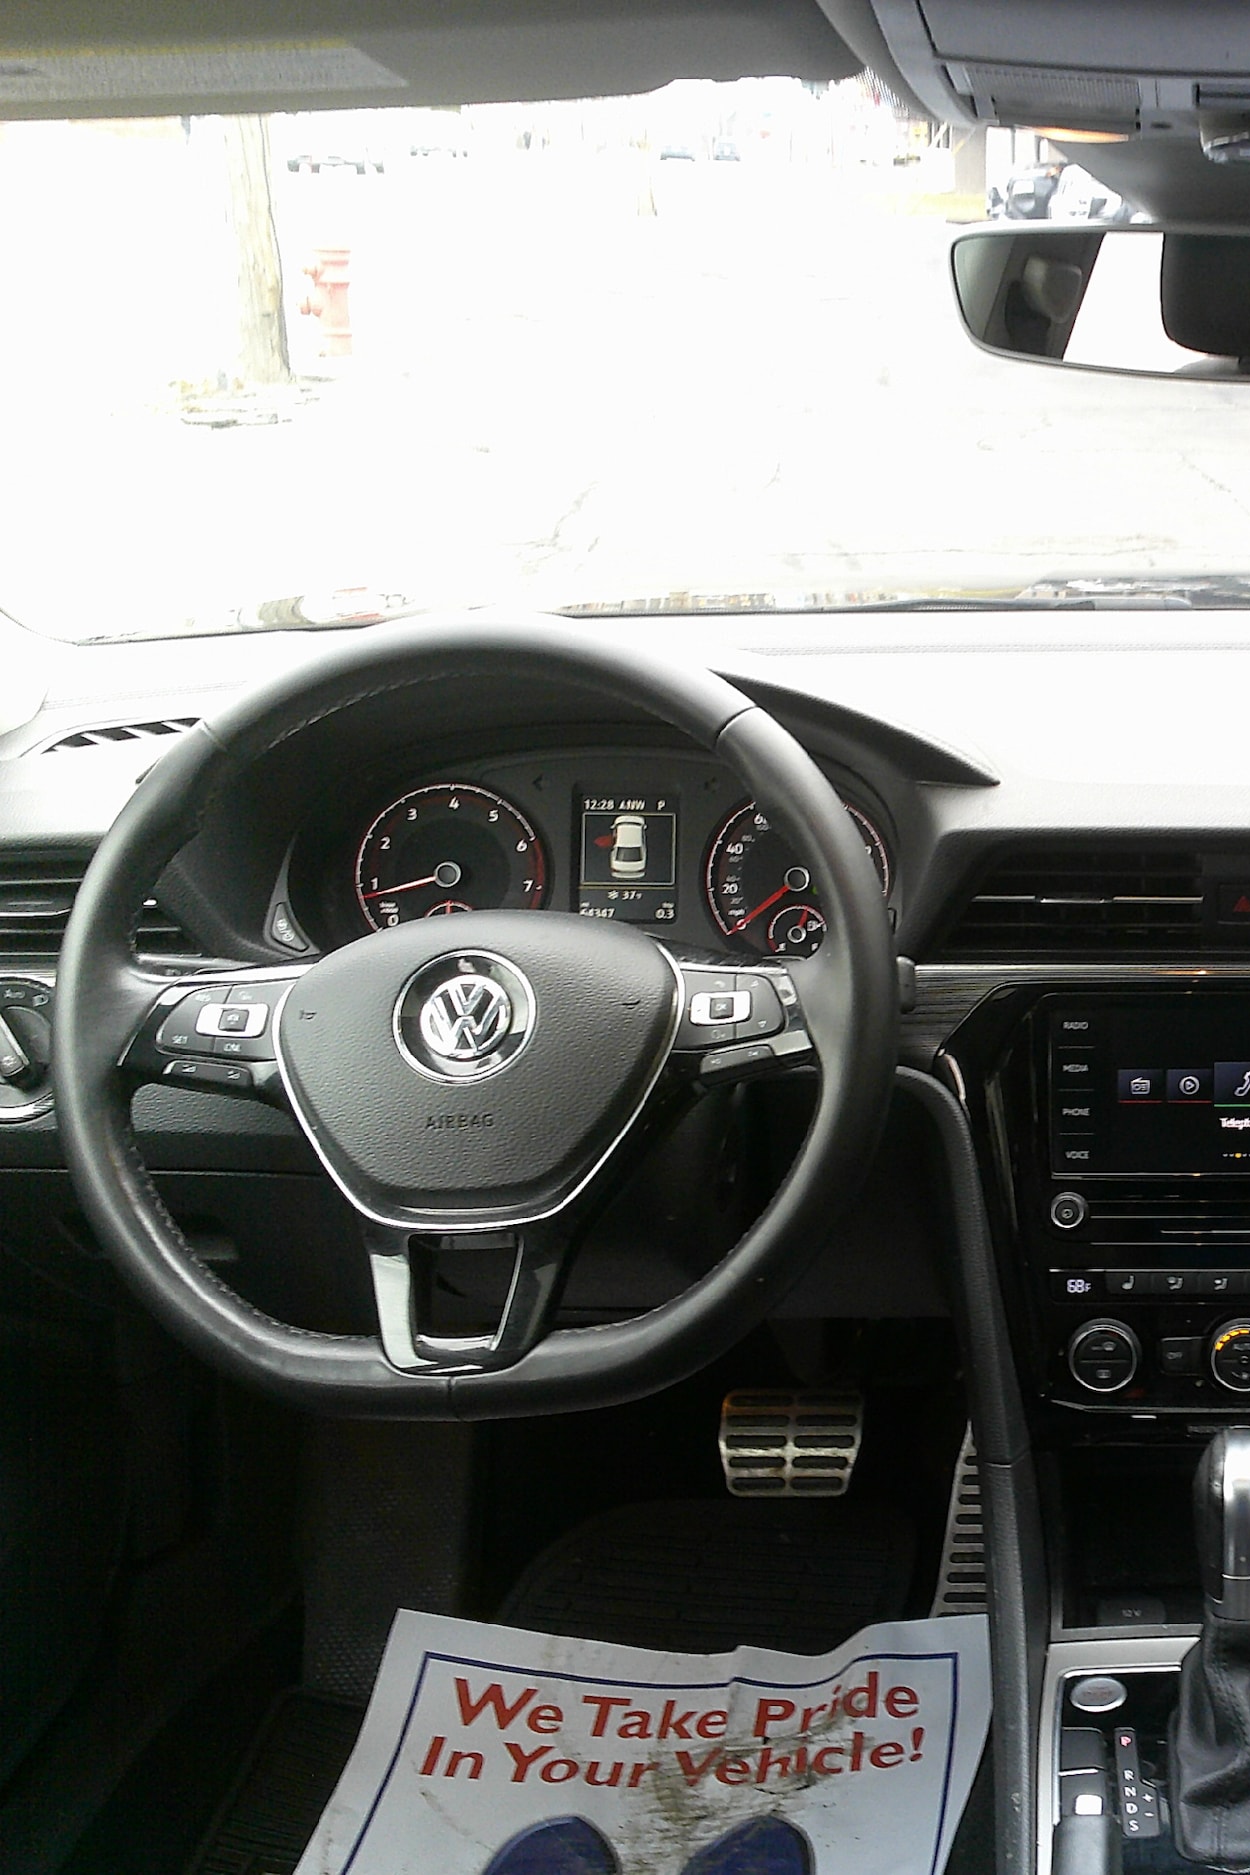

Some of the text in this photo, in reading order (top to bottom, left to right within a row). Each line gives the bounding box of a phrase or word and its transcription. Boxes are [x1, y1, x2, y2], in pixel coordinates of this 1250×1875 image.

[449, 797, 460, 810] 4
[584, 799, 615, 810] 12:28
[657, 800, 666, 811] P
[406, 808, 418, 821] 3
[488, 810, 499, 822] 5
[380, 837, 391, 850] 2
[516, 840, 528, 852] 6
[726, 842, 744, 855] 40
[370, 877, 379, 890] 1
[523, 880, 534, 893] 7
[721, 883, 739, 894] 20
[655, 908, 675, 919] 0.3
[387, 914, 399, 927] 0
[1062, 1021, 1089, 1030] RADIO
[171, 1035, 188, 1045] SET
[1062, 1064, 1089, 1073] MEDIA
[1062, 1107, 1091, 1116] PHONE
[424, 1113, 495, 1131] AIRBAG
[1065, 1150, 1090, 1159] VOICE
[454, 1671, 919, 1740] We Take Pride
[1120, 1736, 1132, 1747] P
[419, 1727, 925, 1788] In Your Vehicle!
[1124, 1769, 1135, 1781] R
[1124, 1786, 1137, 1797] N
[1125, 1802, 1138, 1814] D
[1128, 1820, 1140, 1832] S
